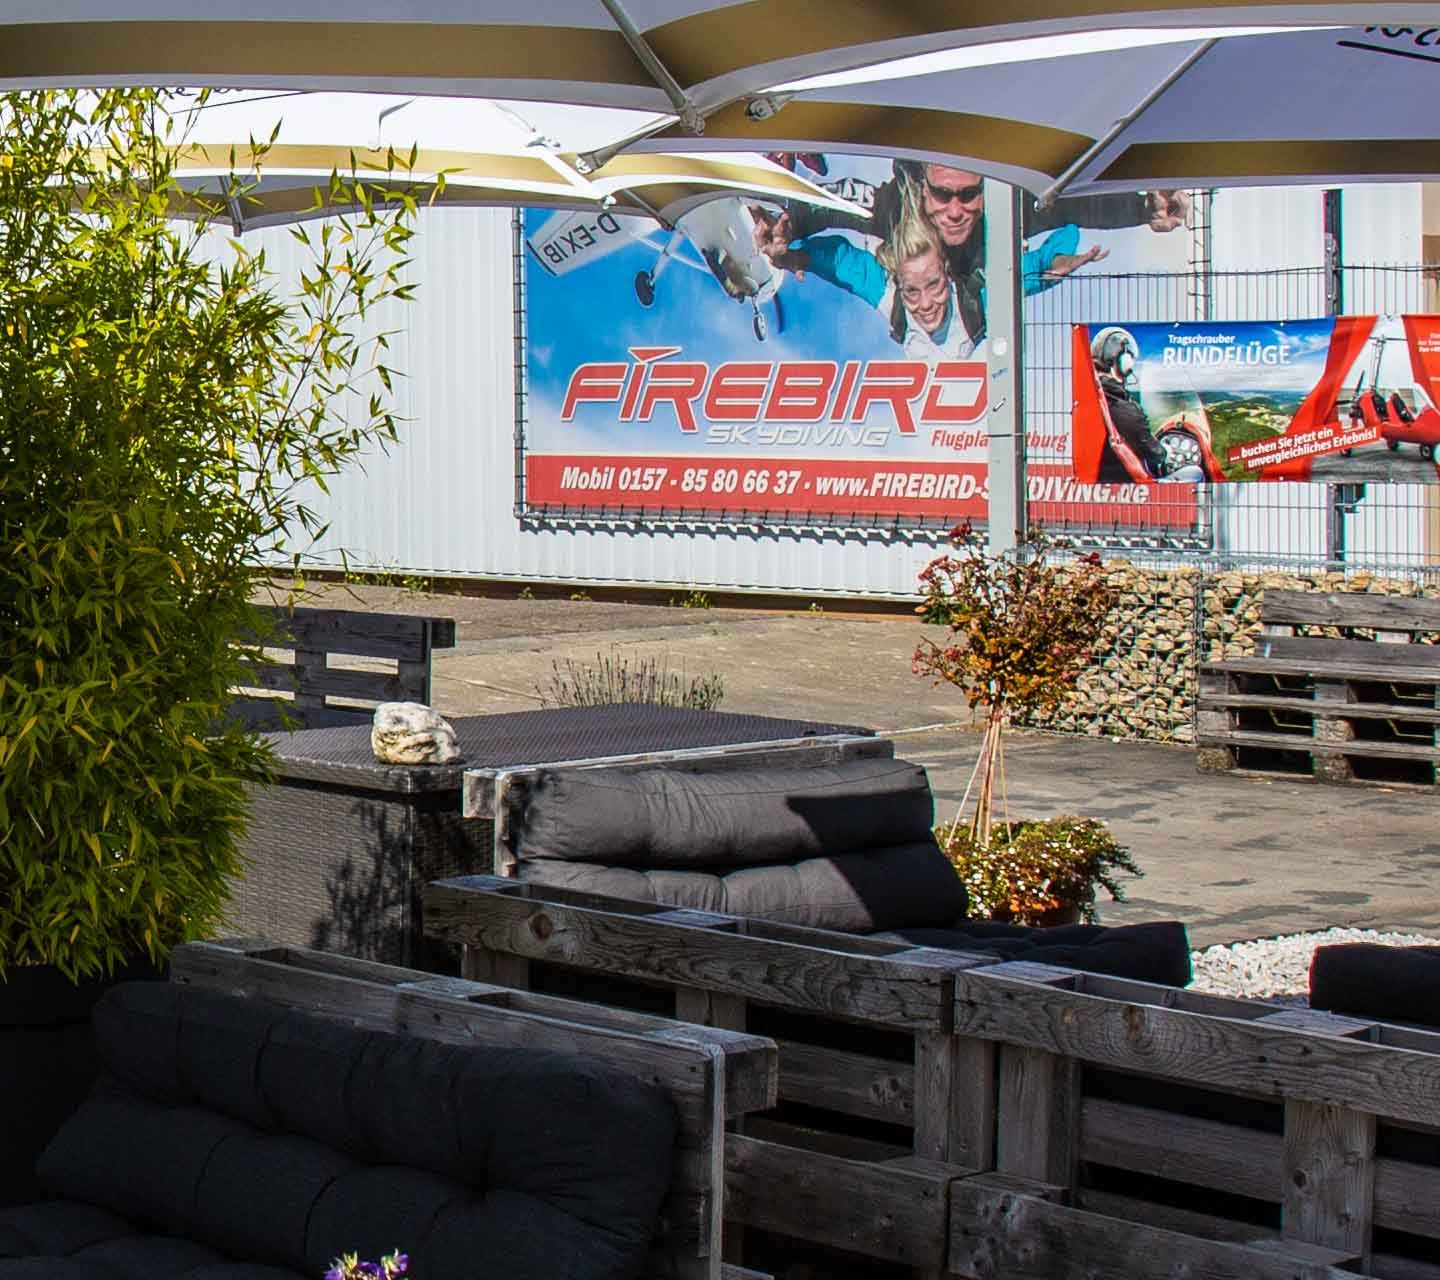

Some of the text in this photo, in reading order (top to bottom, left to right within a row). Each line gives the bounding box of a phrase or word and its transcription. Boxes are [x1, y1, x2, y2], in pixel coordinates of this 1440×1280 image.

[1163, 341, 1291, 366] RUNDFLÜGE
[1168, 334, 1236, 346] Tragschrauber
[930, 428, 989, 451] Flugpla
[1241, 443, 1276, 459] buchen
[1278, 437, 1293, 449] Sie
[1294, 431, 1316, 448] jetzt
[1317, 428, 1334, 440] ein
[1247, 427, 1378, 468] unvergleichliches Erlebnis!
[560, 466, 616, 491] Mobil
[618, 467, 668, 492] 0157
[682, 469, 707, 493] 85
[711, 470, 738, 494] 80
[743, 470, 770, 494] 66
[773, 470, 802, 495] 37
